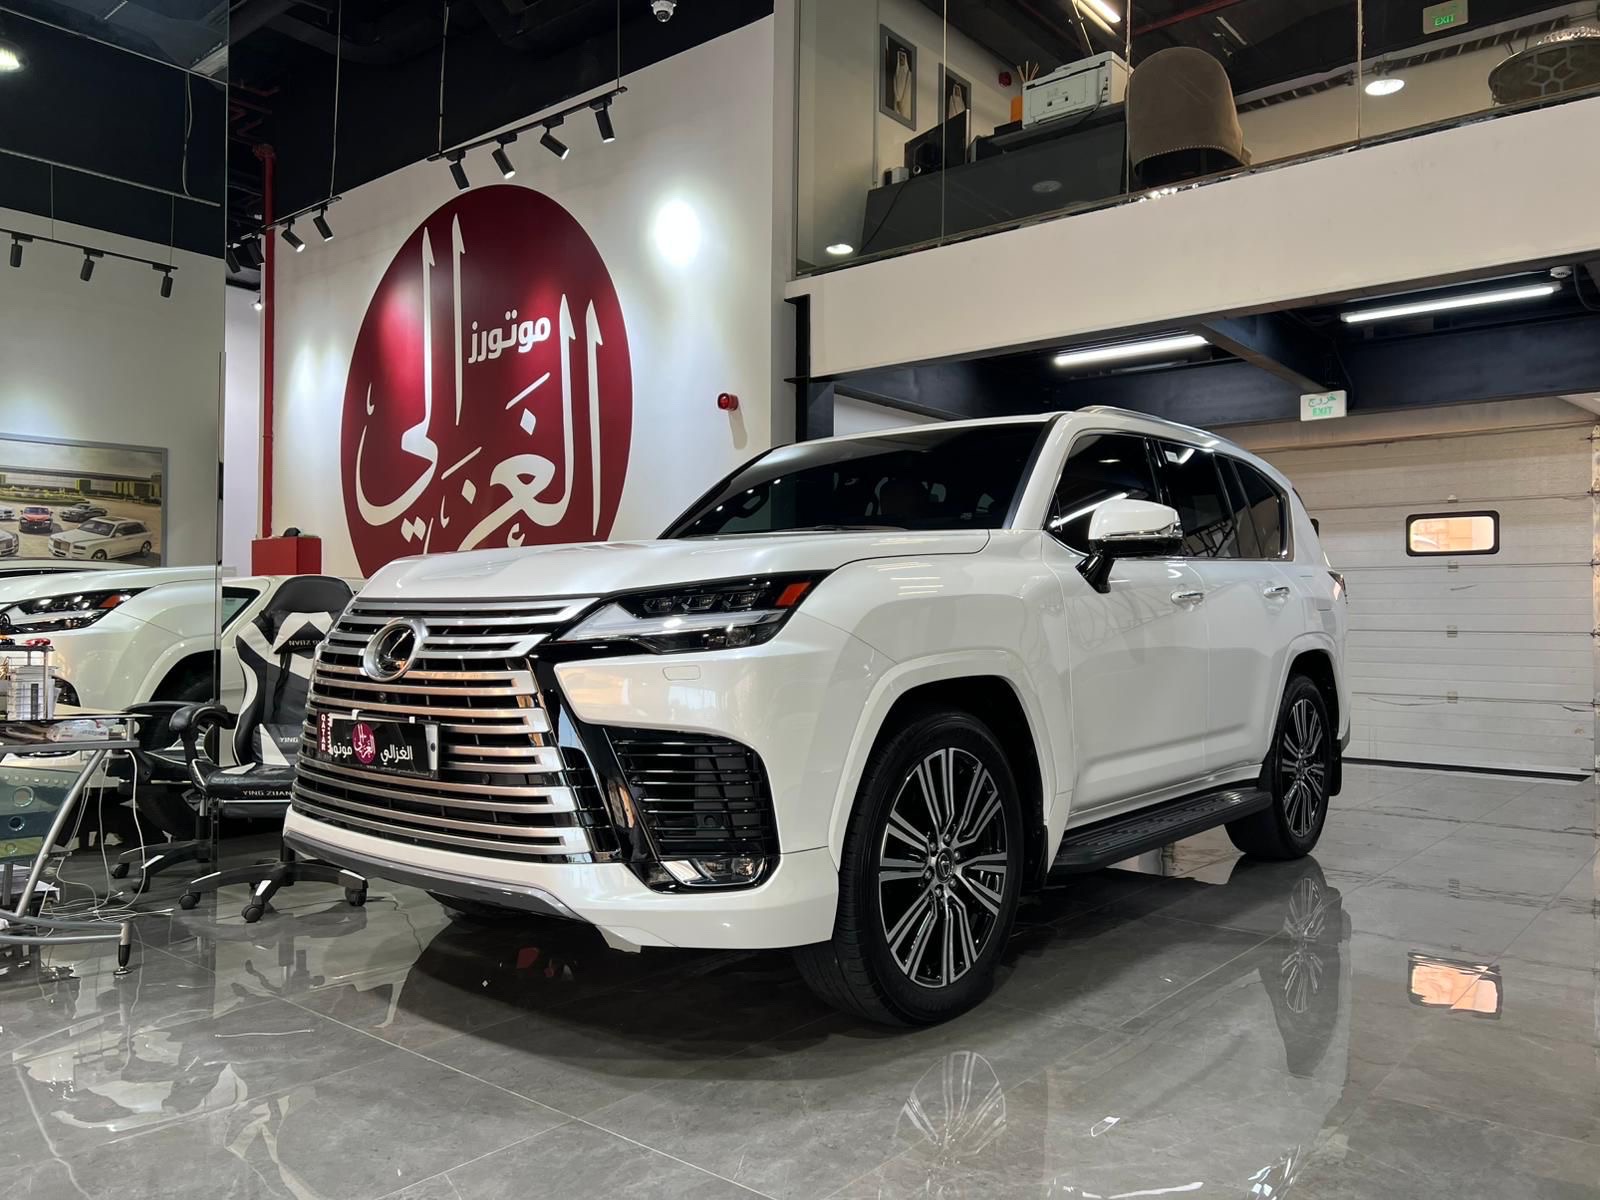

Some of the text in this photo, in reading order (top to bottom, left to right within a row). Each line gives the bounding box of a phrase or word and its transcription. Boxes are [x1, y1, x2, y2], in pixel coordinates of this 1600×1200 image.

[1434, 14, 1455, 26] EXIT
[468, 309, 551, 364] موتورز
[1312, 406, 1333, 417] EXIT
[380, 744, 413, 765] الغزالي
